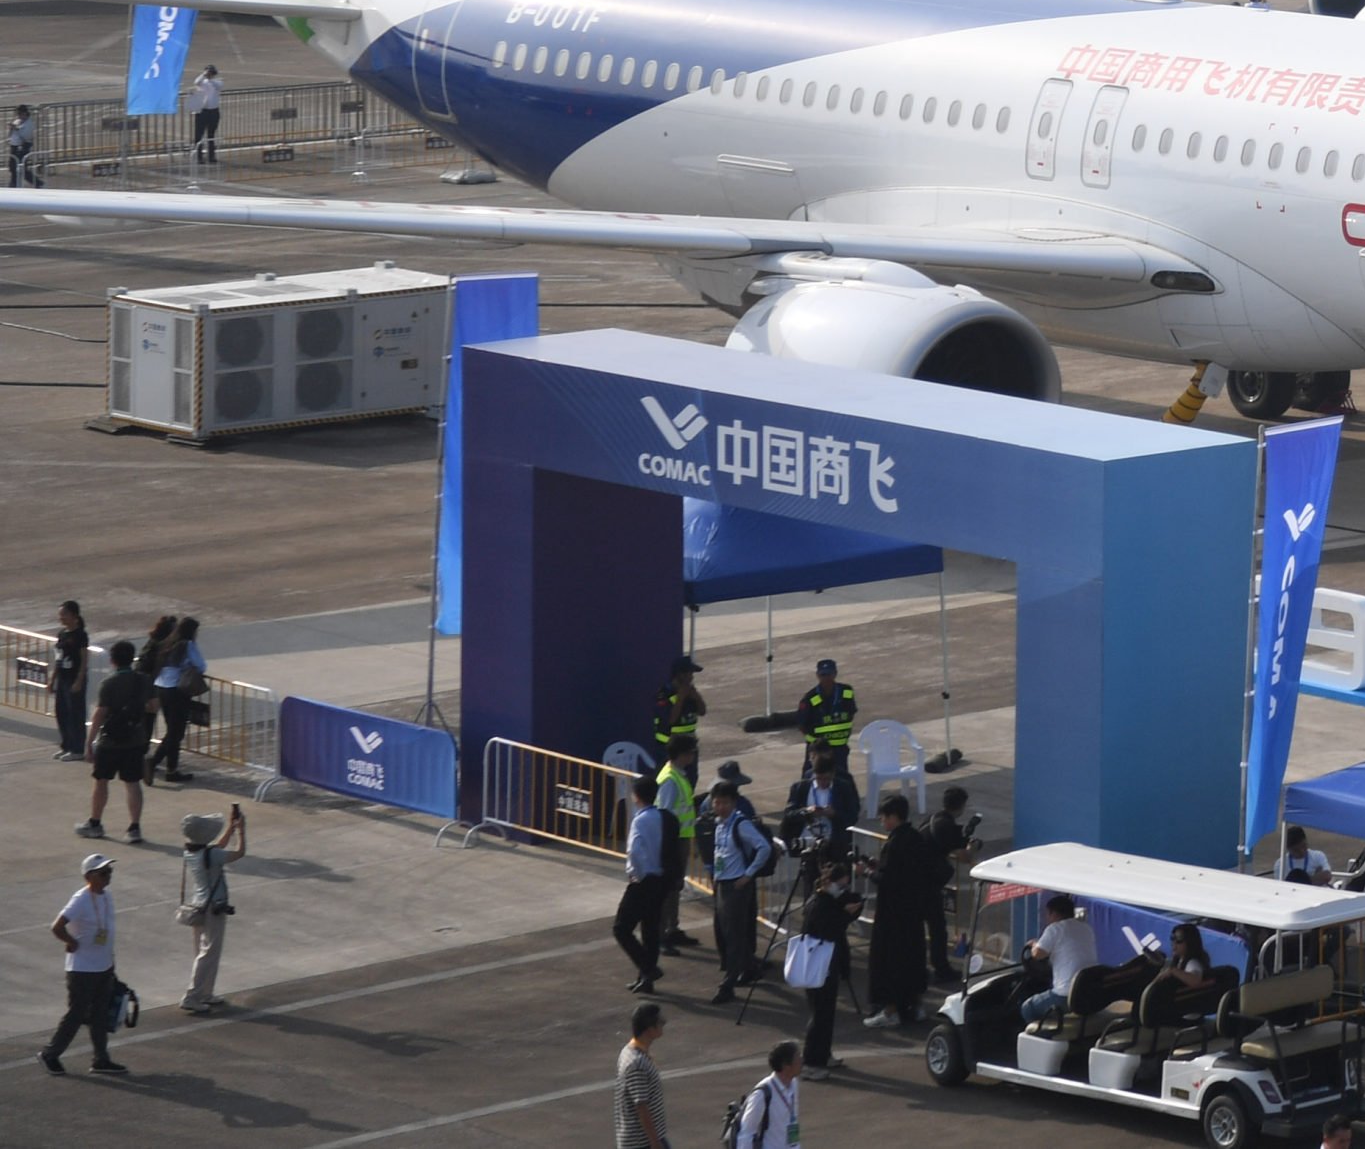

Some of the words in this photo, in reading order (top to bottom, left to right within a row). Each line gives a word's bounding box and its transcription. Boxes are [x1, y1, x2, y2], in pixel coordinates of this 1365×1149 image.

[638, 453, 711, 486] COMAC
[717, 419, 899, 514] 中国商飞
[1272, 554, 1296, 720] COMC
[347, 773, 385, 790] COMAC
